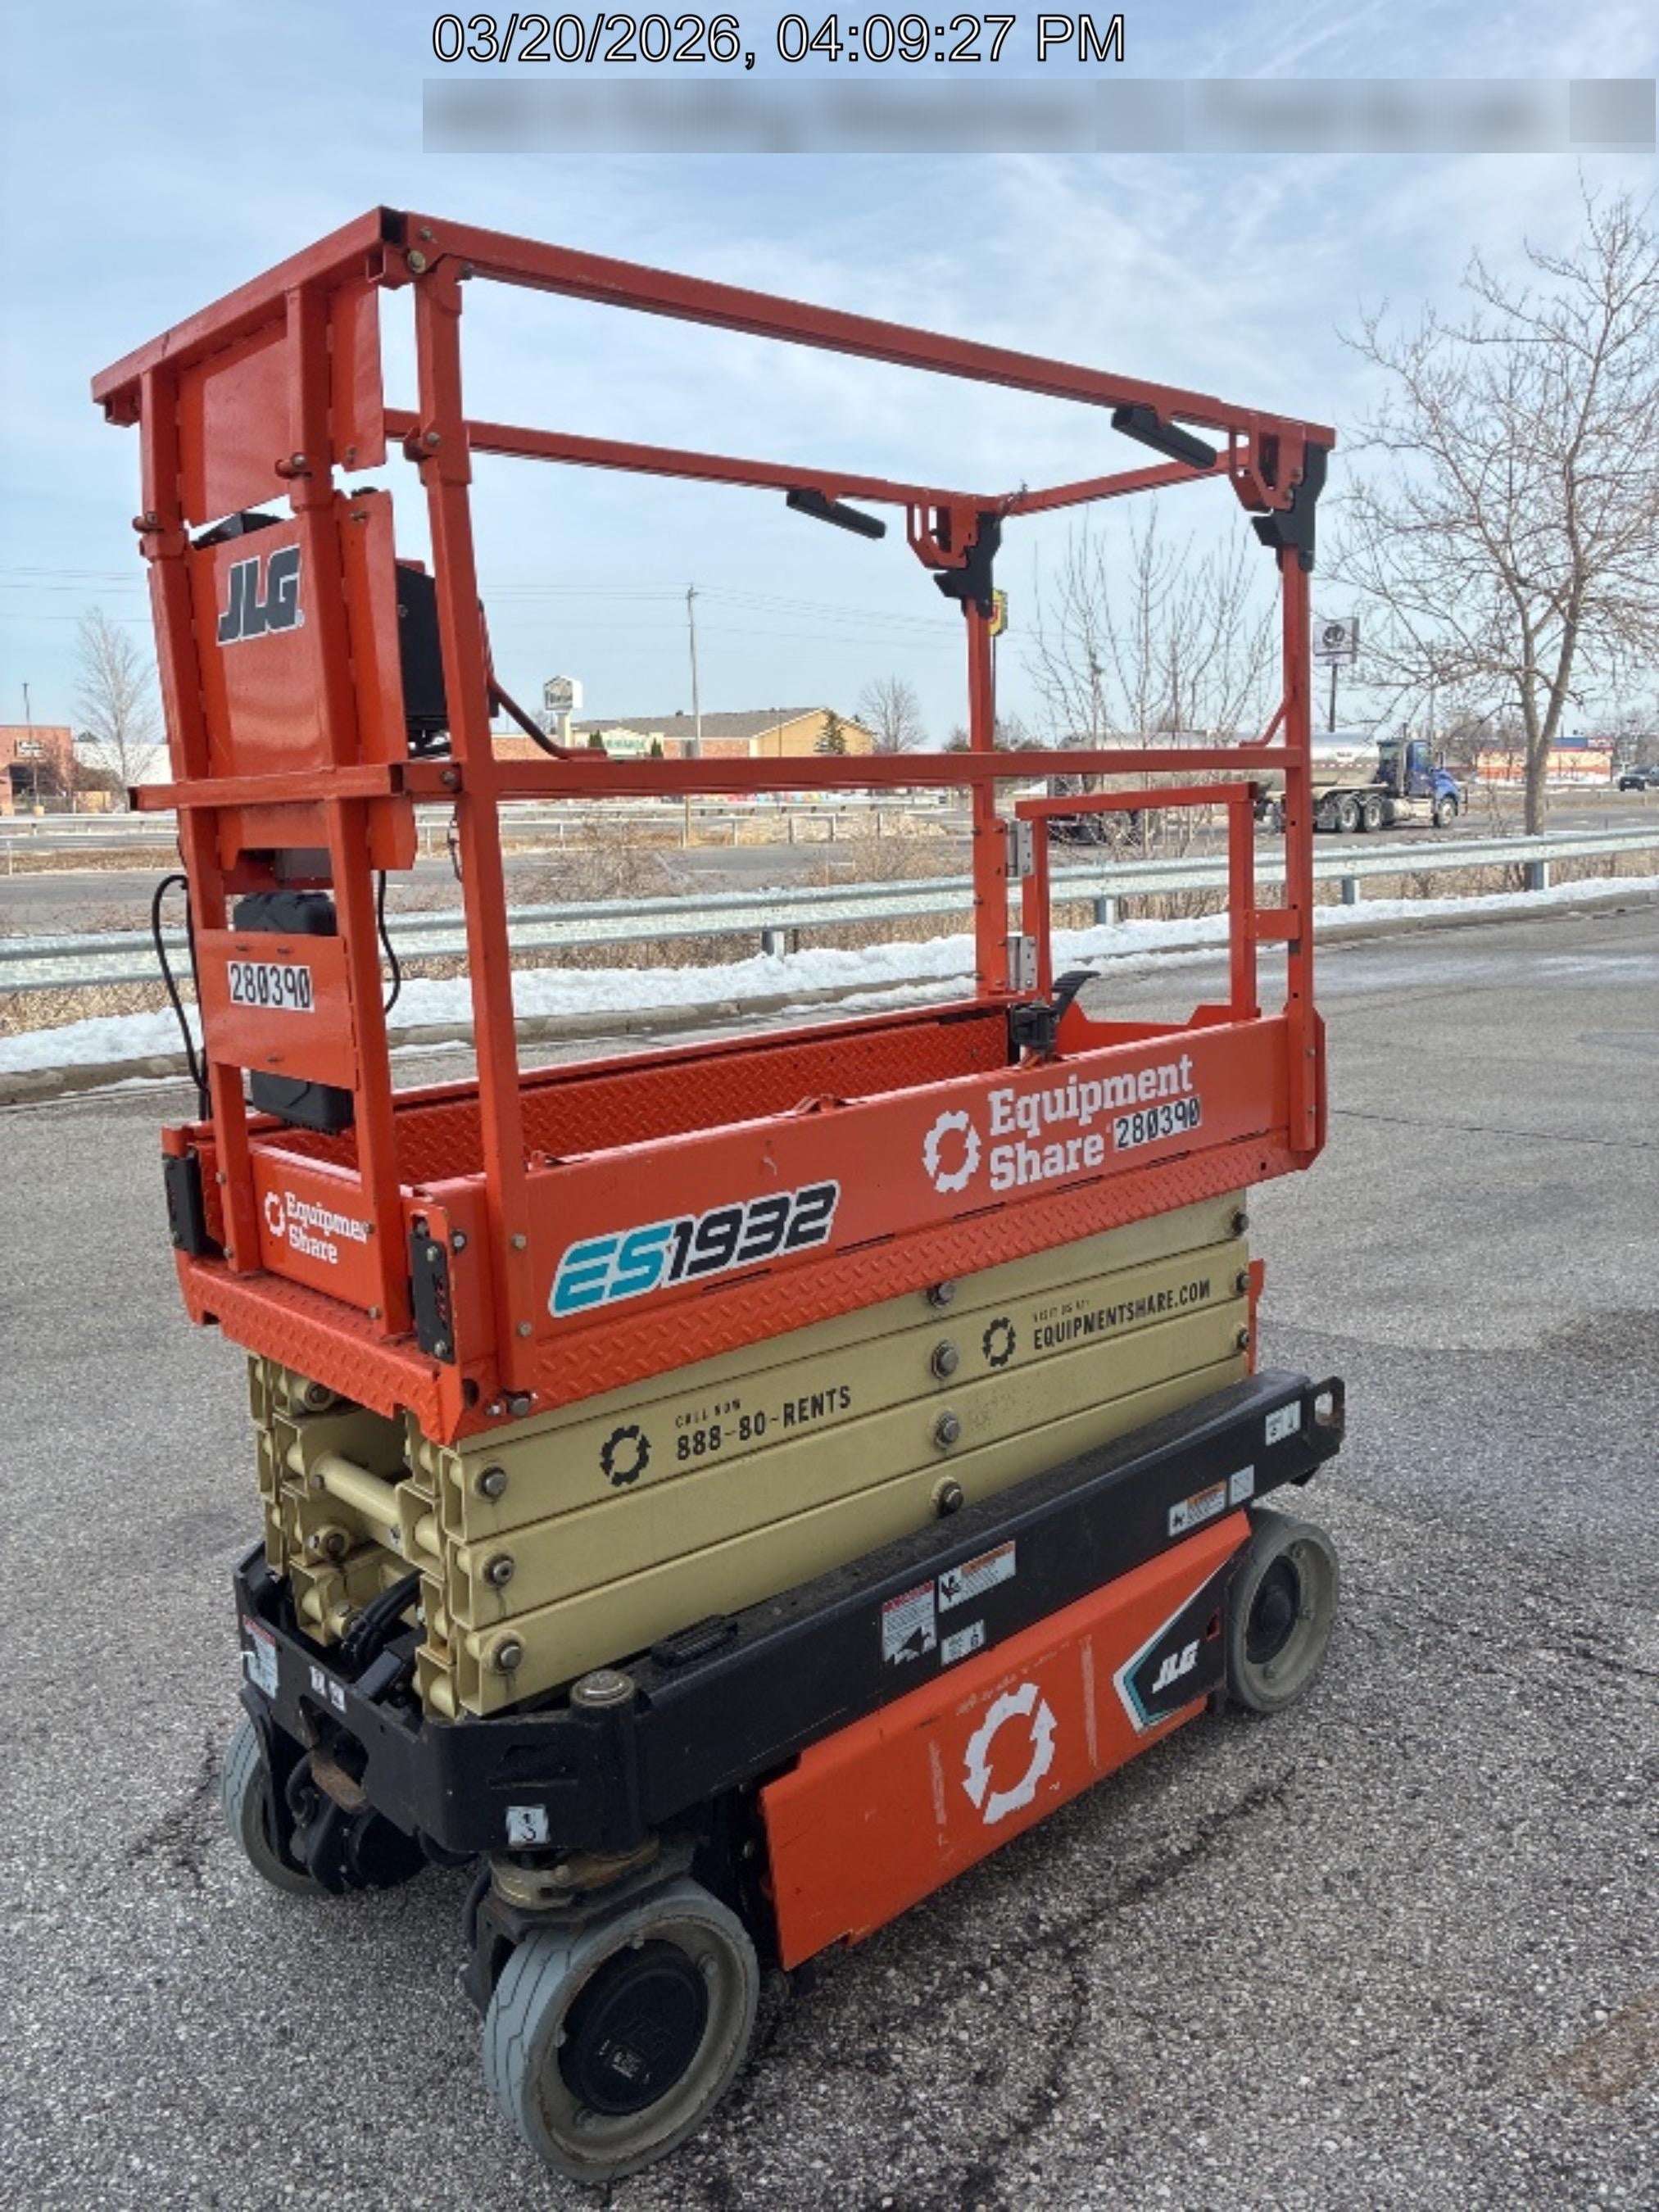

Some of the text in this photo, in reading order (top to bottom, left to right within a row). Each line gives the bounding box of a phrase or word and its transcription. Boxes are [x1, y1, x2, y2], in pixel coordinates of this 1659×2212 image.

[217, 544, 302, 645] JLG
[230, 963, 310, 1009] 280390
[988, 1054, 1193, 1138] Equipment
[1116, 1097, 1200, 1148] 280390
[990, 1133, 1104, 1190] Share
[289, 1223, 338, 1264] Share
[550, 1180, 840, 1317] ES1932
[1033, 1278, 1210, 1351] EQUIPMENTSHARE.COM
[677, 1385, 851, 1461] 888-80-RENTS
[1152, 1639, 1200, 1694] JLG
